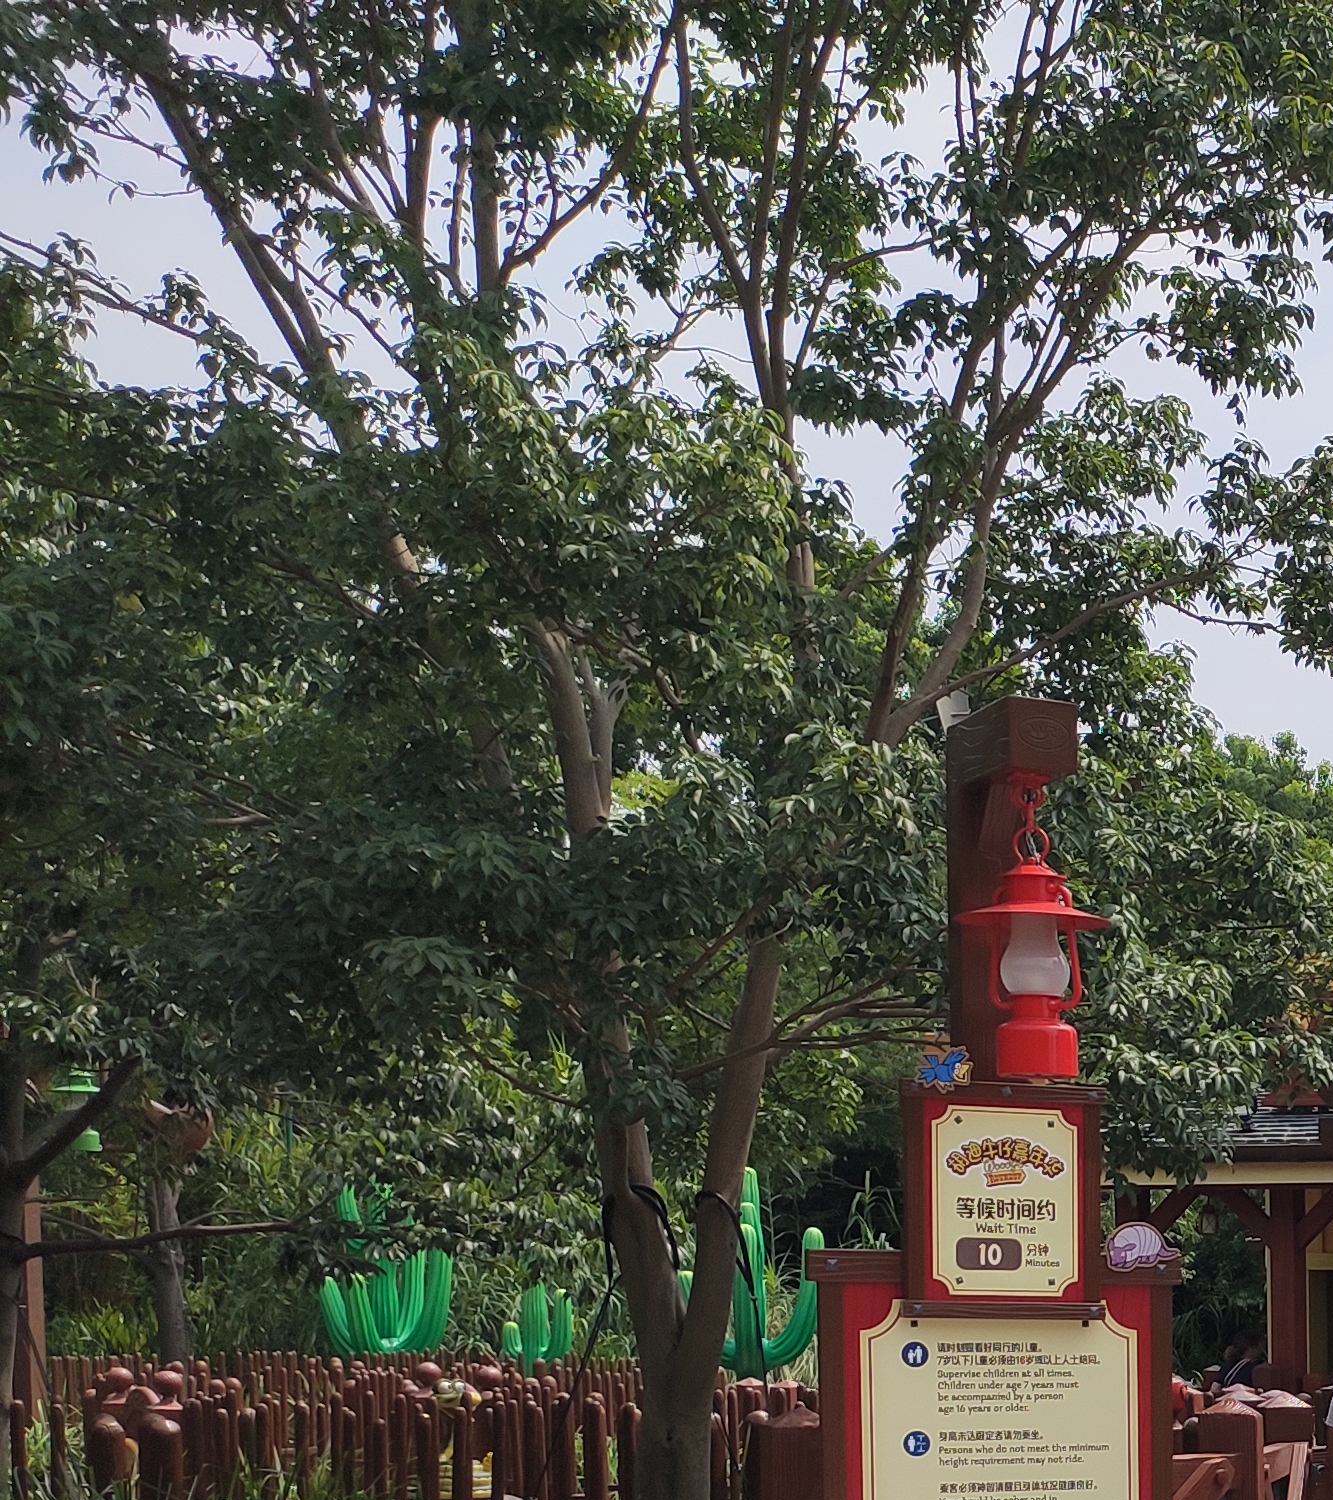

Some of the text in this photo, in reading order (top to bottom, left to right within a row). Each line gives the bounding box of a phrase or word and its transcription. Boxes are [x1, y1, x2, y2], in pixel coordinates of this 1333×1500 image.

[947, 1138, 1064, 1177] 胡迪牛仔嘉年华
[956, 1197, 1055, 1221] 等候时间约
[976, 1223, 1036, 1234] Wait Time
[979, 1243, 1002, 1265] 10
[1027, 1244, 1049, 1256] 分钟
[1026, 1259, 1060, 1267] Minutes
[937, 1370, 981, 1380] Supervise
[983, 1369, 1019, 1377] children
[1034, 1369, 1044, 1377] all
[937, 1381, 975, 1389] Children
[978, 1381, 1003, 1389] under
[1006, 1383, 1021, 1391] age
[1031, 1382, 1054, 1391] years
[938, 1393, 949, 1401] be
[951, 1393, 1010, 1403] accompanied
[1014, 1391, 1024, 1402] by
[1034, 1393, 1063, 1403] person
[938, 1405, 954, 1415] age
[968, 1405, 991, 1415] years
[1006, 1404, 1029, 1412] older.
[939, 1445, 973, 1454] Persons
[975, 1444, 993, 1453] who
[996, 1444, 1007, 1453] do
[1009, 1445, 1025, 1453] not
[1052, 1443, 1066, 1452] the
[1069, 1443, 1109, 1452] minimum
[939, 1457, 968, 1467] height
[971, 1456, 1025, 1467] requirement
[1027, 1457, 1045, 1466] may
[1065, 1454, 1084, 1463] ride.
